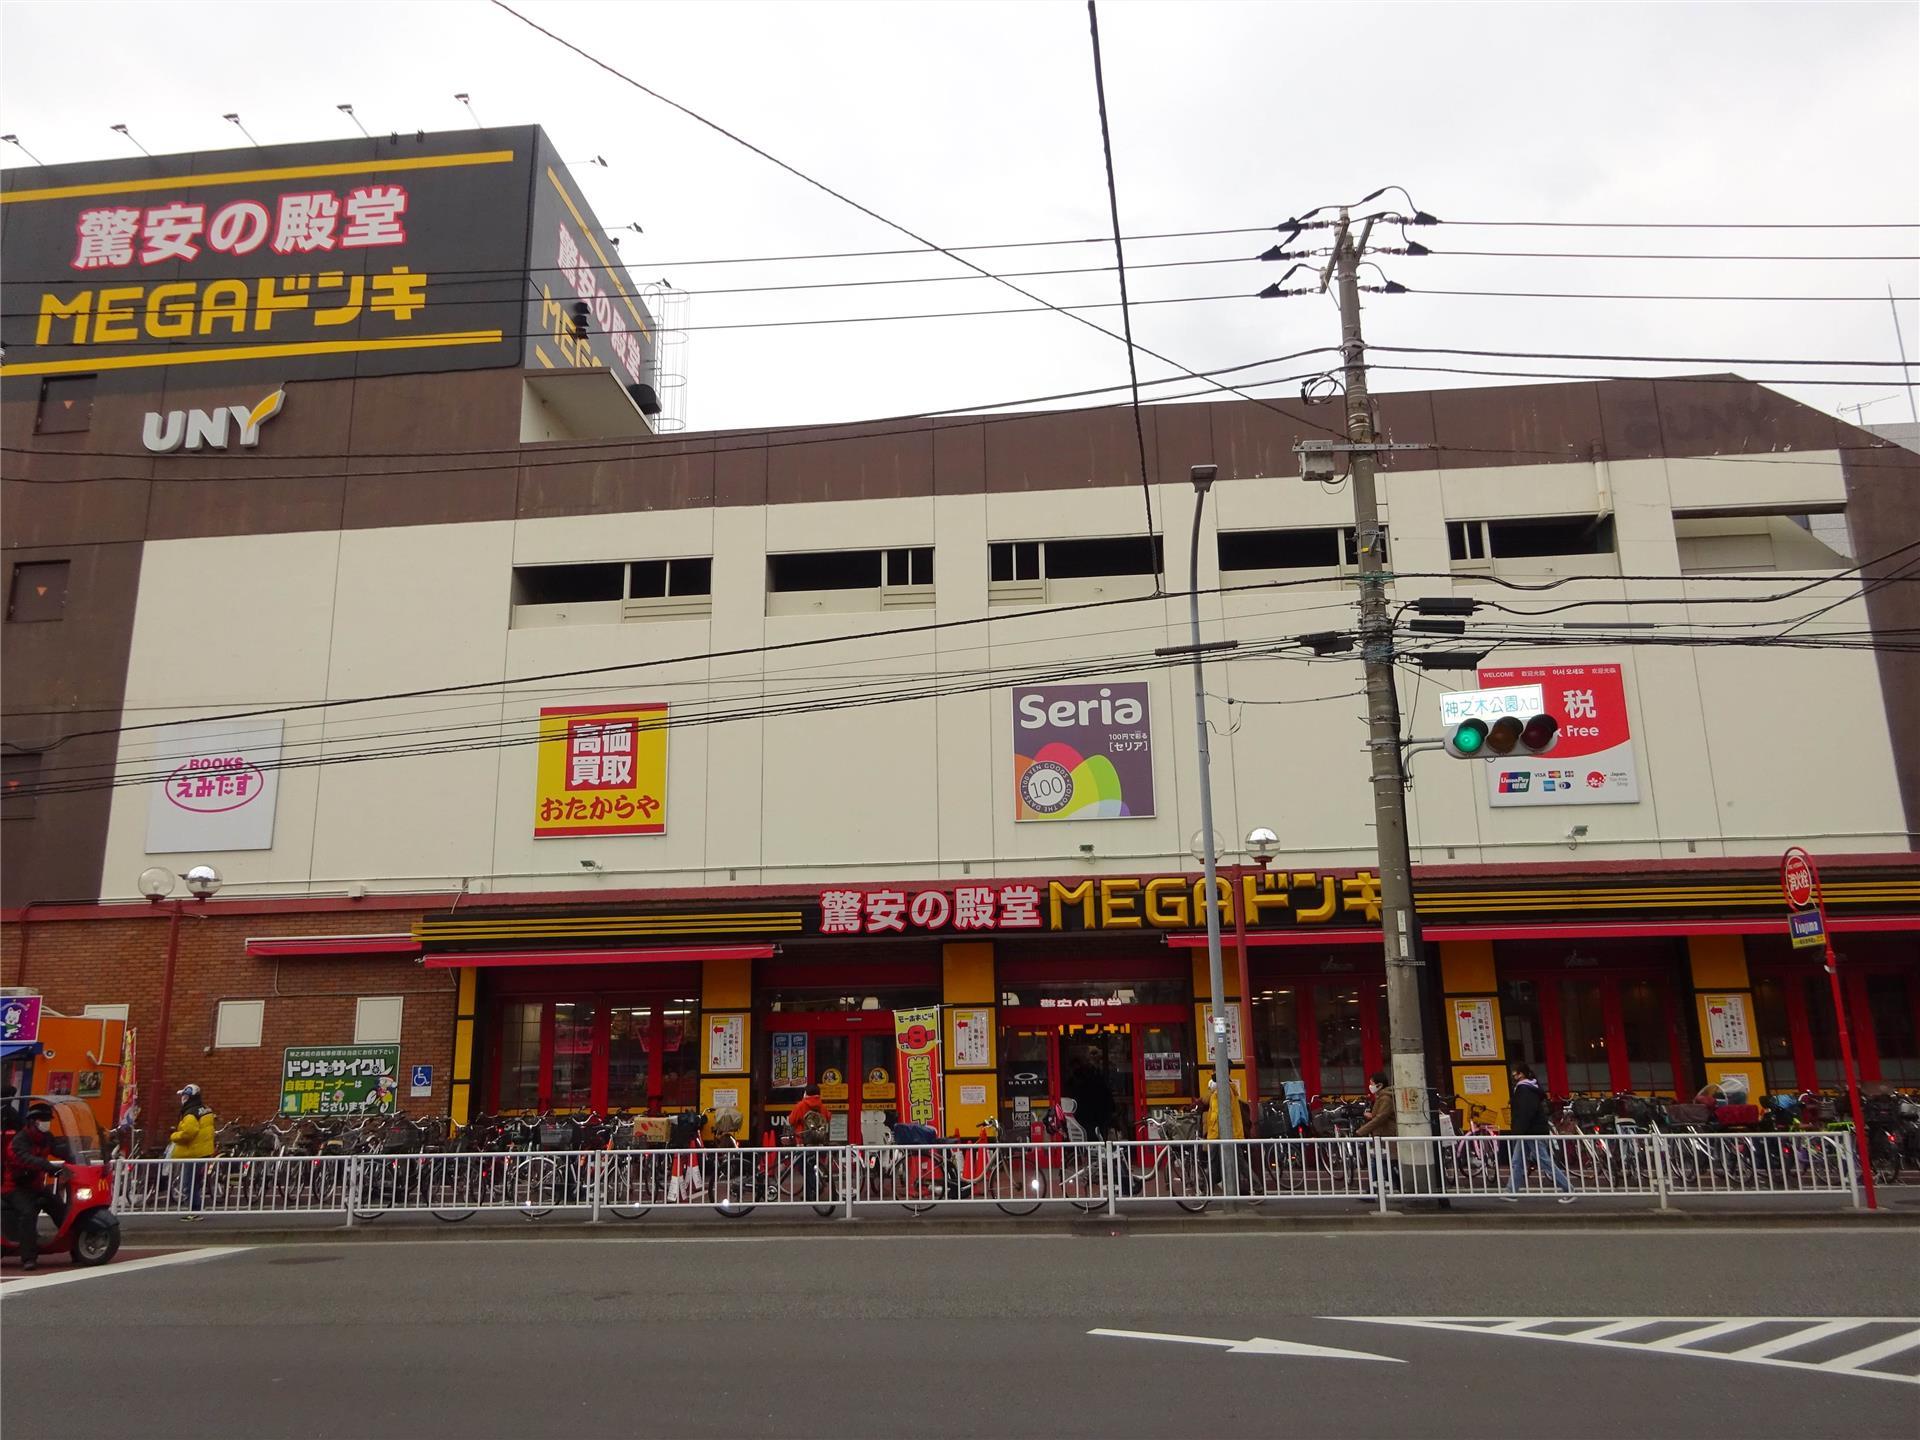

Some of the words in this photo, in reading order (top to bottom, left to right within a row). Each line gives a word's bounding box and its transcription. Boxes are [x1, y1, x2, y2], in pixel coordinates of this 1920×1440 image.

[71, 185, 407, 269] 驚安の殿堂
[37, 266, 428, 345] MEGAドンキ
[142, 389, 286, 452] UNY
[1482, 671, 1514, 679] WELCOME
[1019, 688, 1142, 729] Seria
[571, 722, 633, 754] 高価
[1567, 725, 1599, 737] Free
[189, 757, 244, 771] BOOKS
[571, 755, 632, 786] 買取
[1030, 776, 1064, 799] 100
[540, 794, 660, 822] おたからや
[820, 886, 1042, 933] 驚安の殿堂
[1048, 872, 1382, 930] MEGAドンキ
[285, 1080, 362, 1091] 自転車コーナーは
[907, 1054, 934, 1125] 営業中
